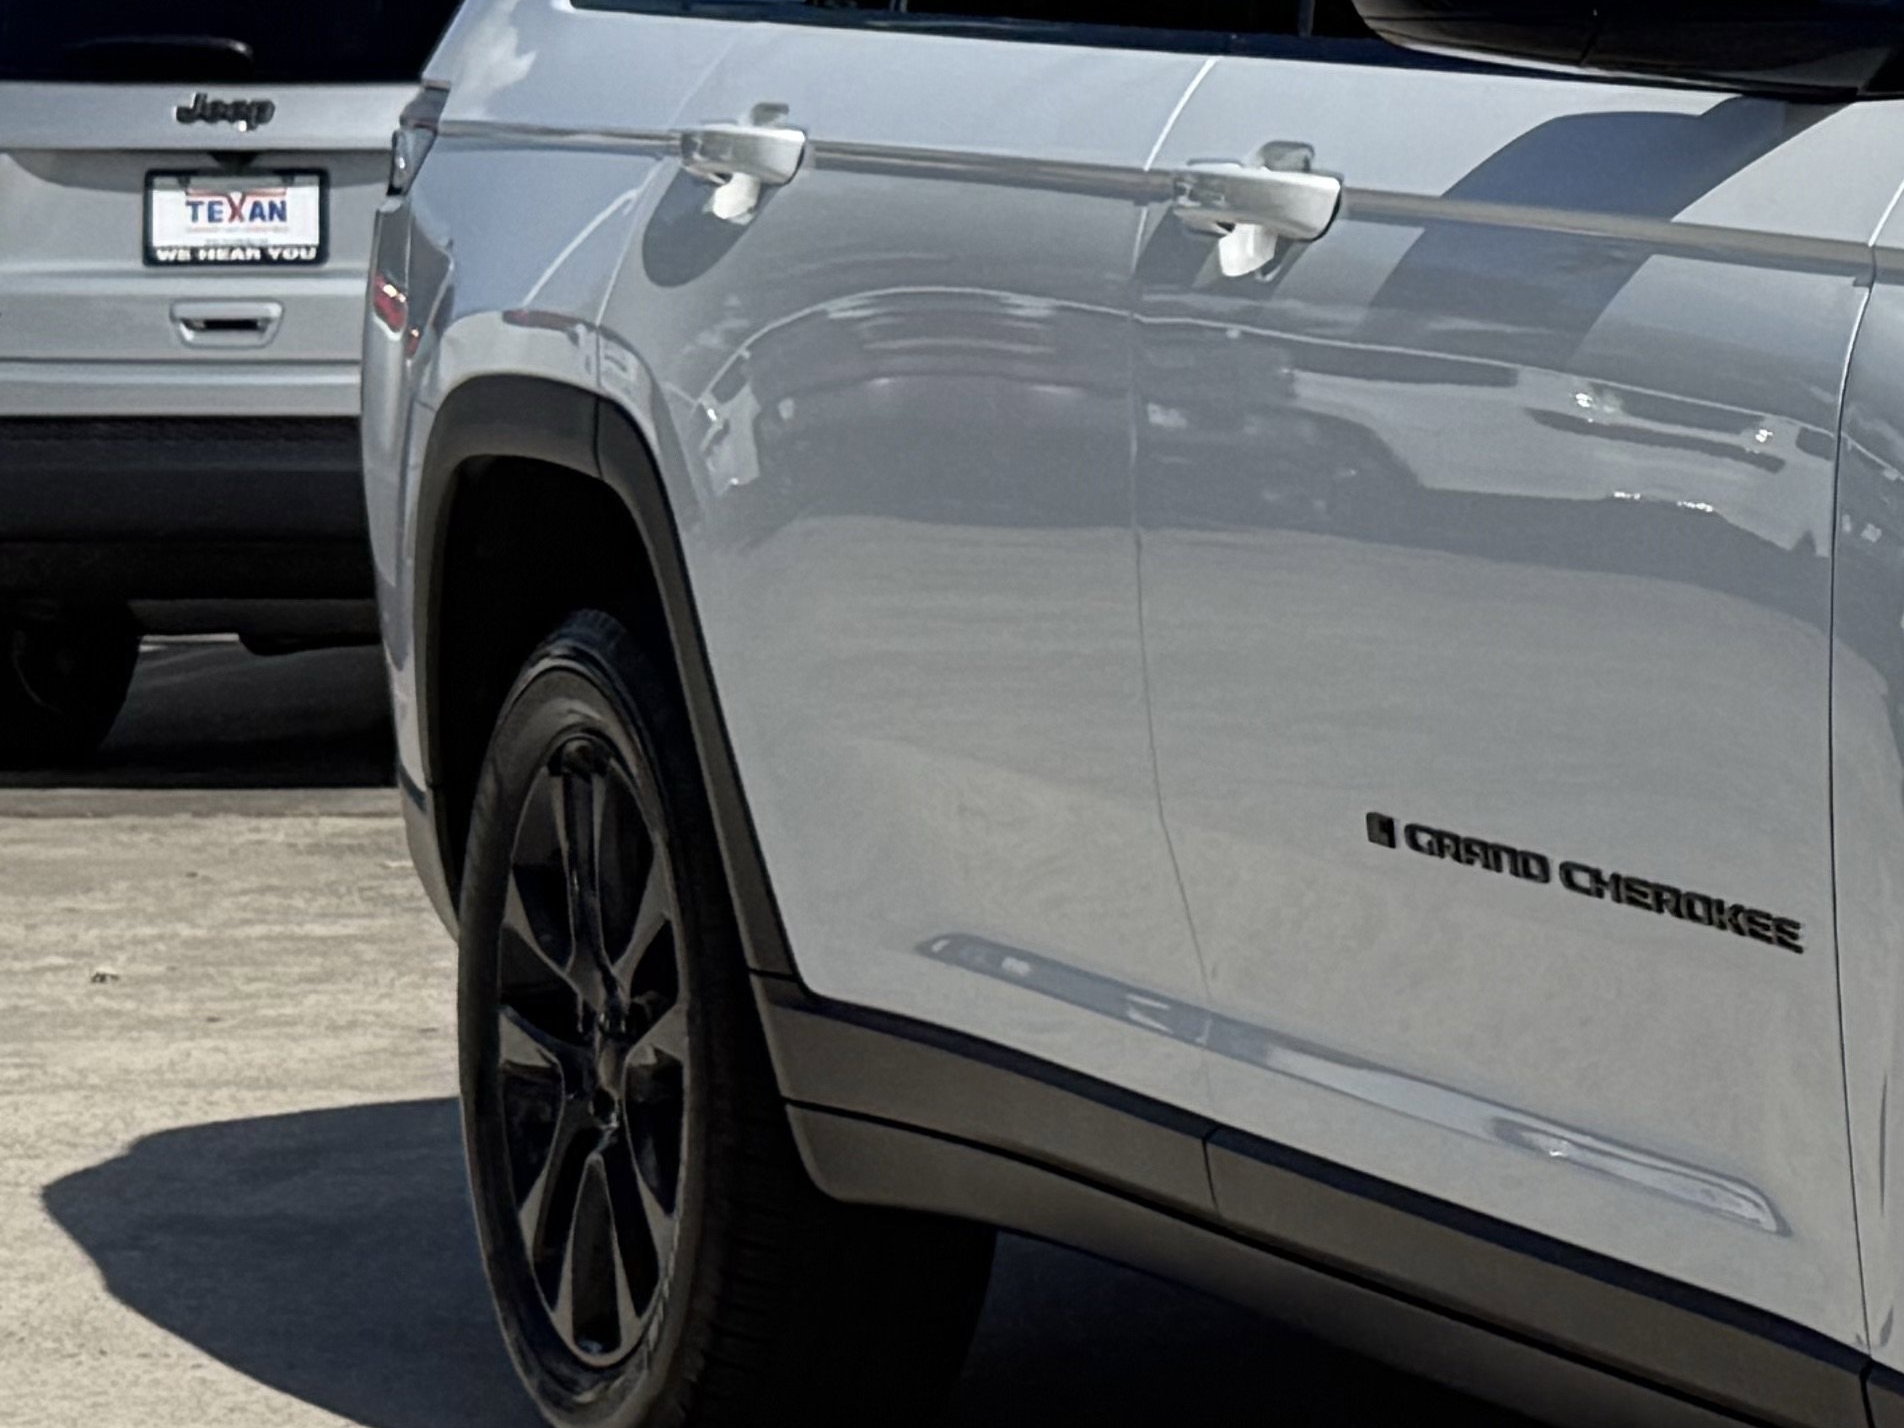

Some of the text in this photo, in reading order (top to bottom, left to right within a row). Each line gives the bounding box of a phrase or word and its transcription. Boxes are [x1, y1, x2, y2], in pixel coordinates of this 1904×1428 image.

[173, 92, 275, 132] Jeep
[185, 193, 288, 223] TEXAN
[156, 246, 317, 262] WE HEAR YOU
[1404, 822, 1551, 884] GRAND
[1559, 861, 1804, 954] CHEROKEE
